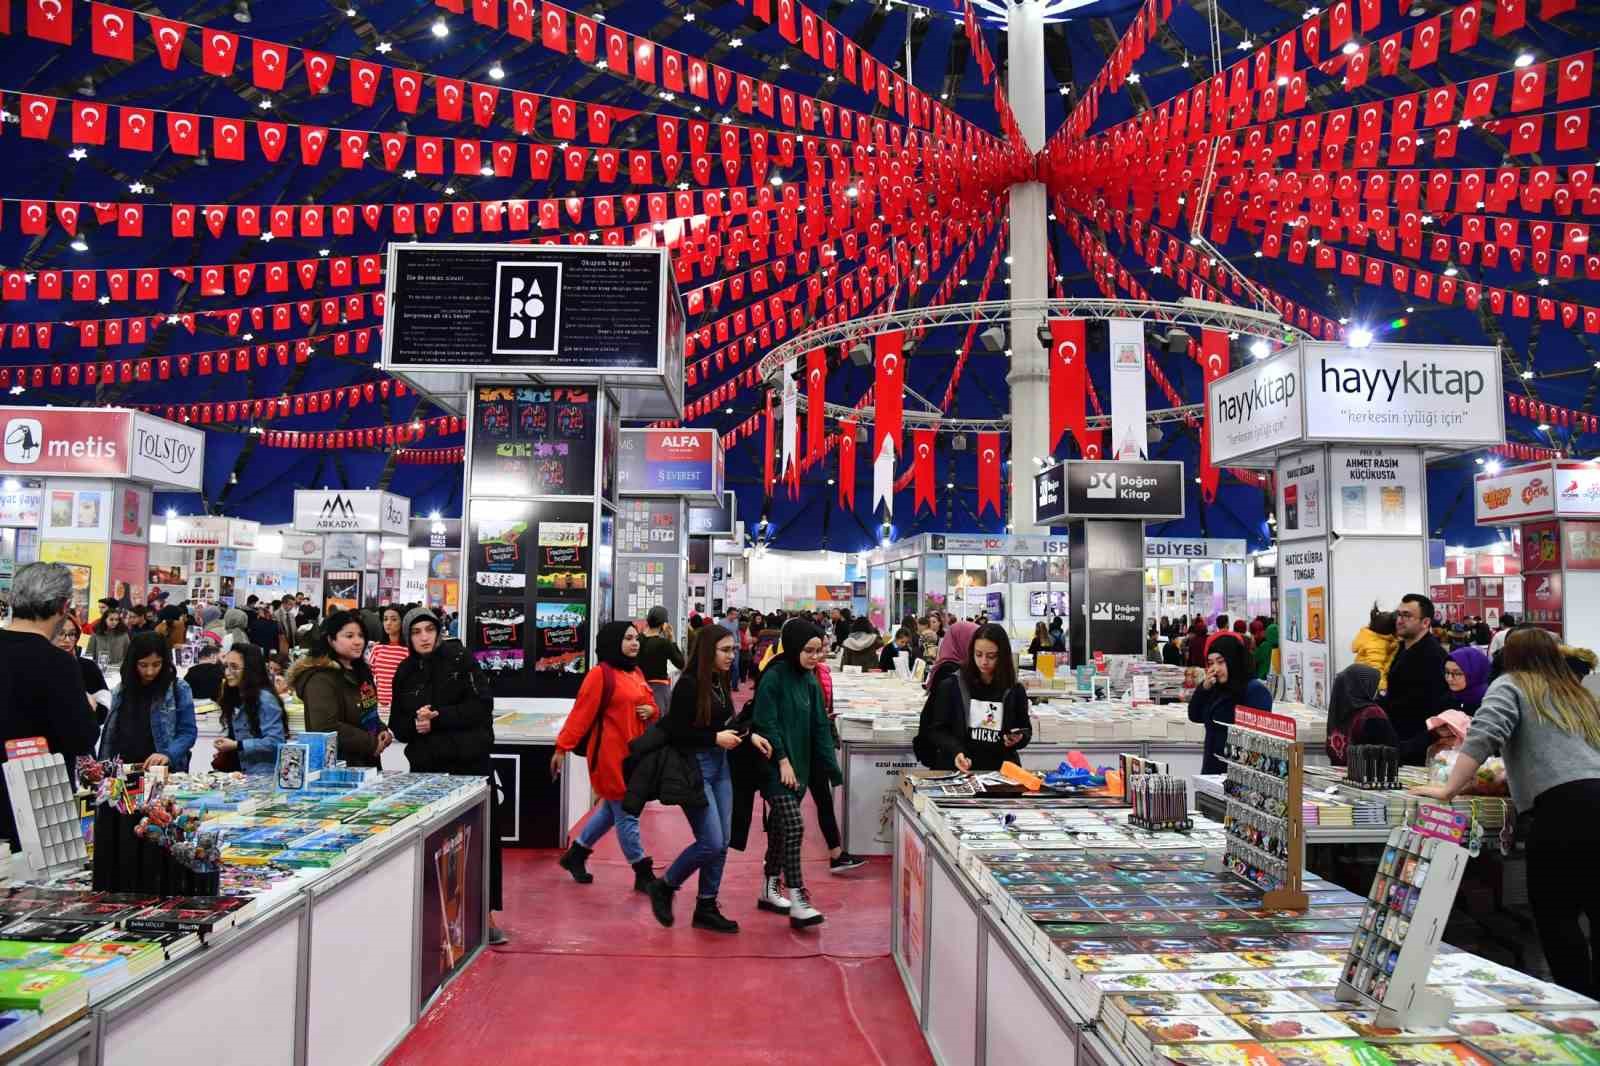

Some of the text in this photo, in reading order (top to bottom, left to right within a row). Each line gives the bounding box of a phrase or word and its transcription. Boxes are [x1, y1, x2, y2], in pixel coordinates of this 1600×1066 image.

[1321, 358, 1484, 403] hayykitap
[1219, 371, 1296, 424] hayykitap
[1402, 410, 1438, 426] iyiliği
[48, 435, 116, 458] metis
[137, 428, 196, 467] TOLSTOY
[662, 435, 700, 448] ALFA
[1346, 456, 1399, 468] AHMET RASİM
[1350, 468, 1396, 482] KÜÇÜKUSTA
[1120, 476, 1158, 488] Doğan
[1120, 489, 1151, 501] Kitap
[316, 520, 360, 528] ARKADYA
[1115, 604, 1140, 614] Doğan
[1115, 612, 1136, 622] Kitap
